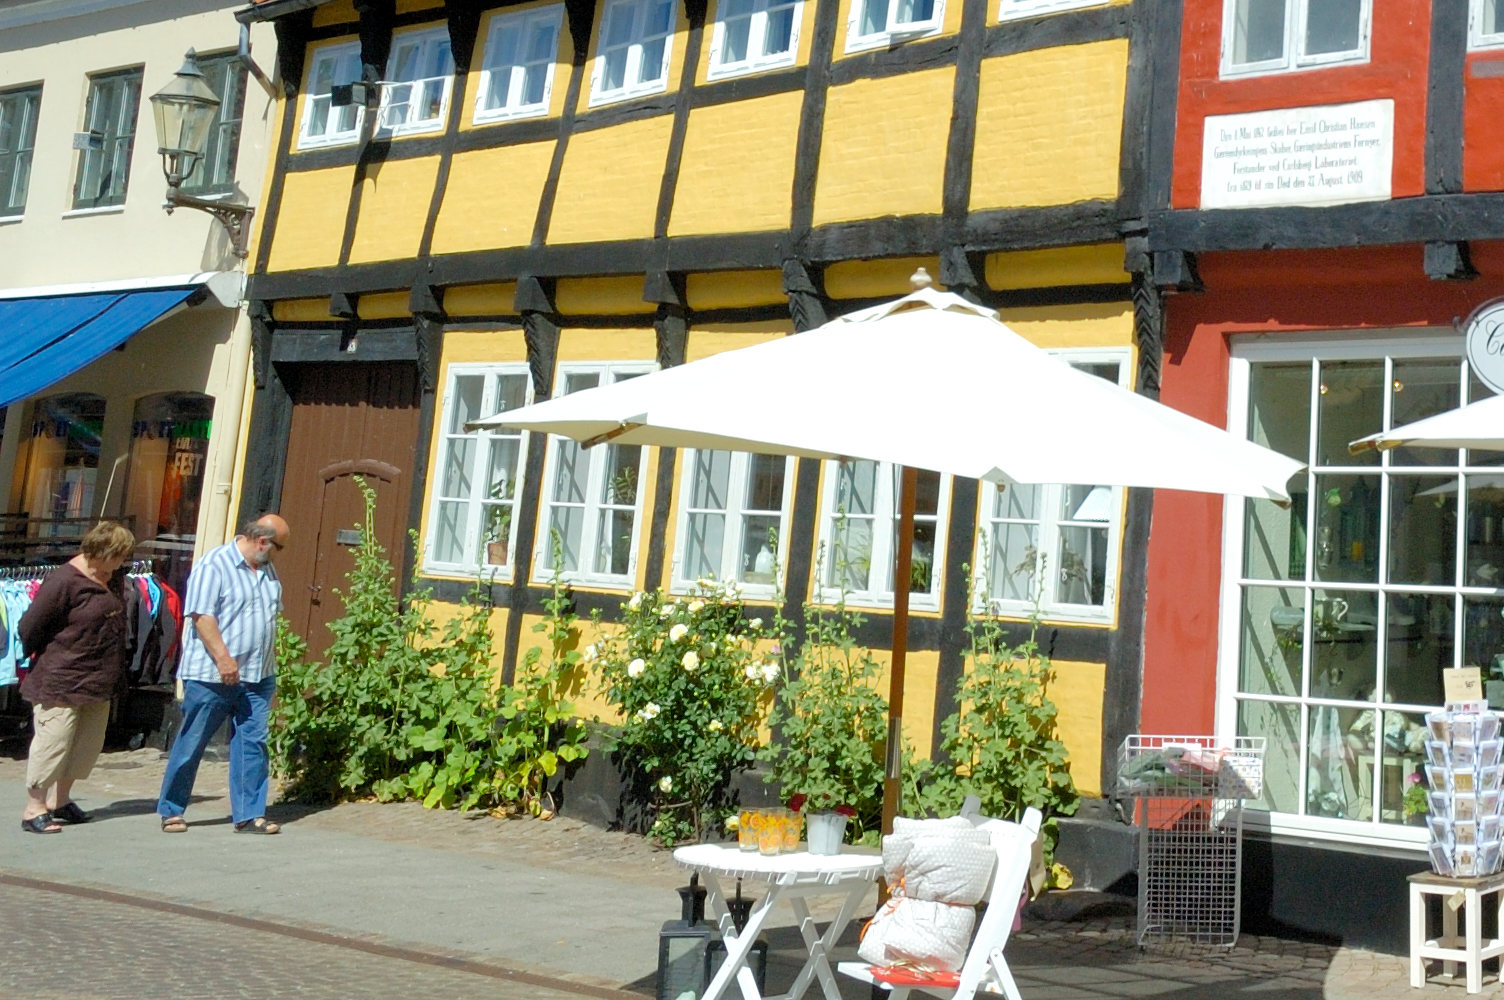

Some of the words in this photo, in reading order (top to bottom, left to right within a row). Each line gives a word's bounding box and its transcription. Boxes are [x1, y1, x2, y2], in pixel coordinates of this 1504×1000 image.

[1299, 121, 1316, 134] Emil
[1318, 119, 1347, 134] Christian
[1350, 116, 1376, 130] Hansen
